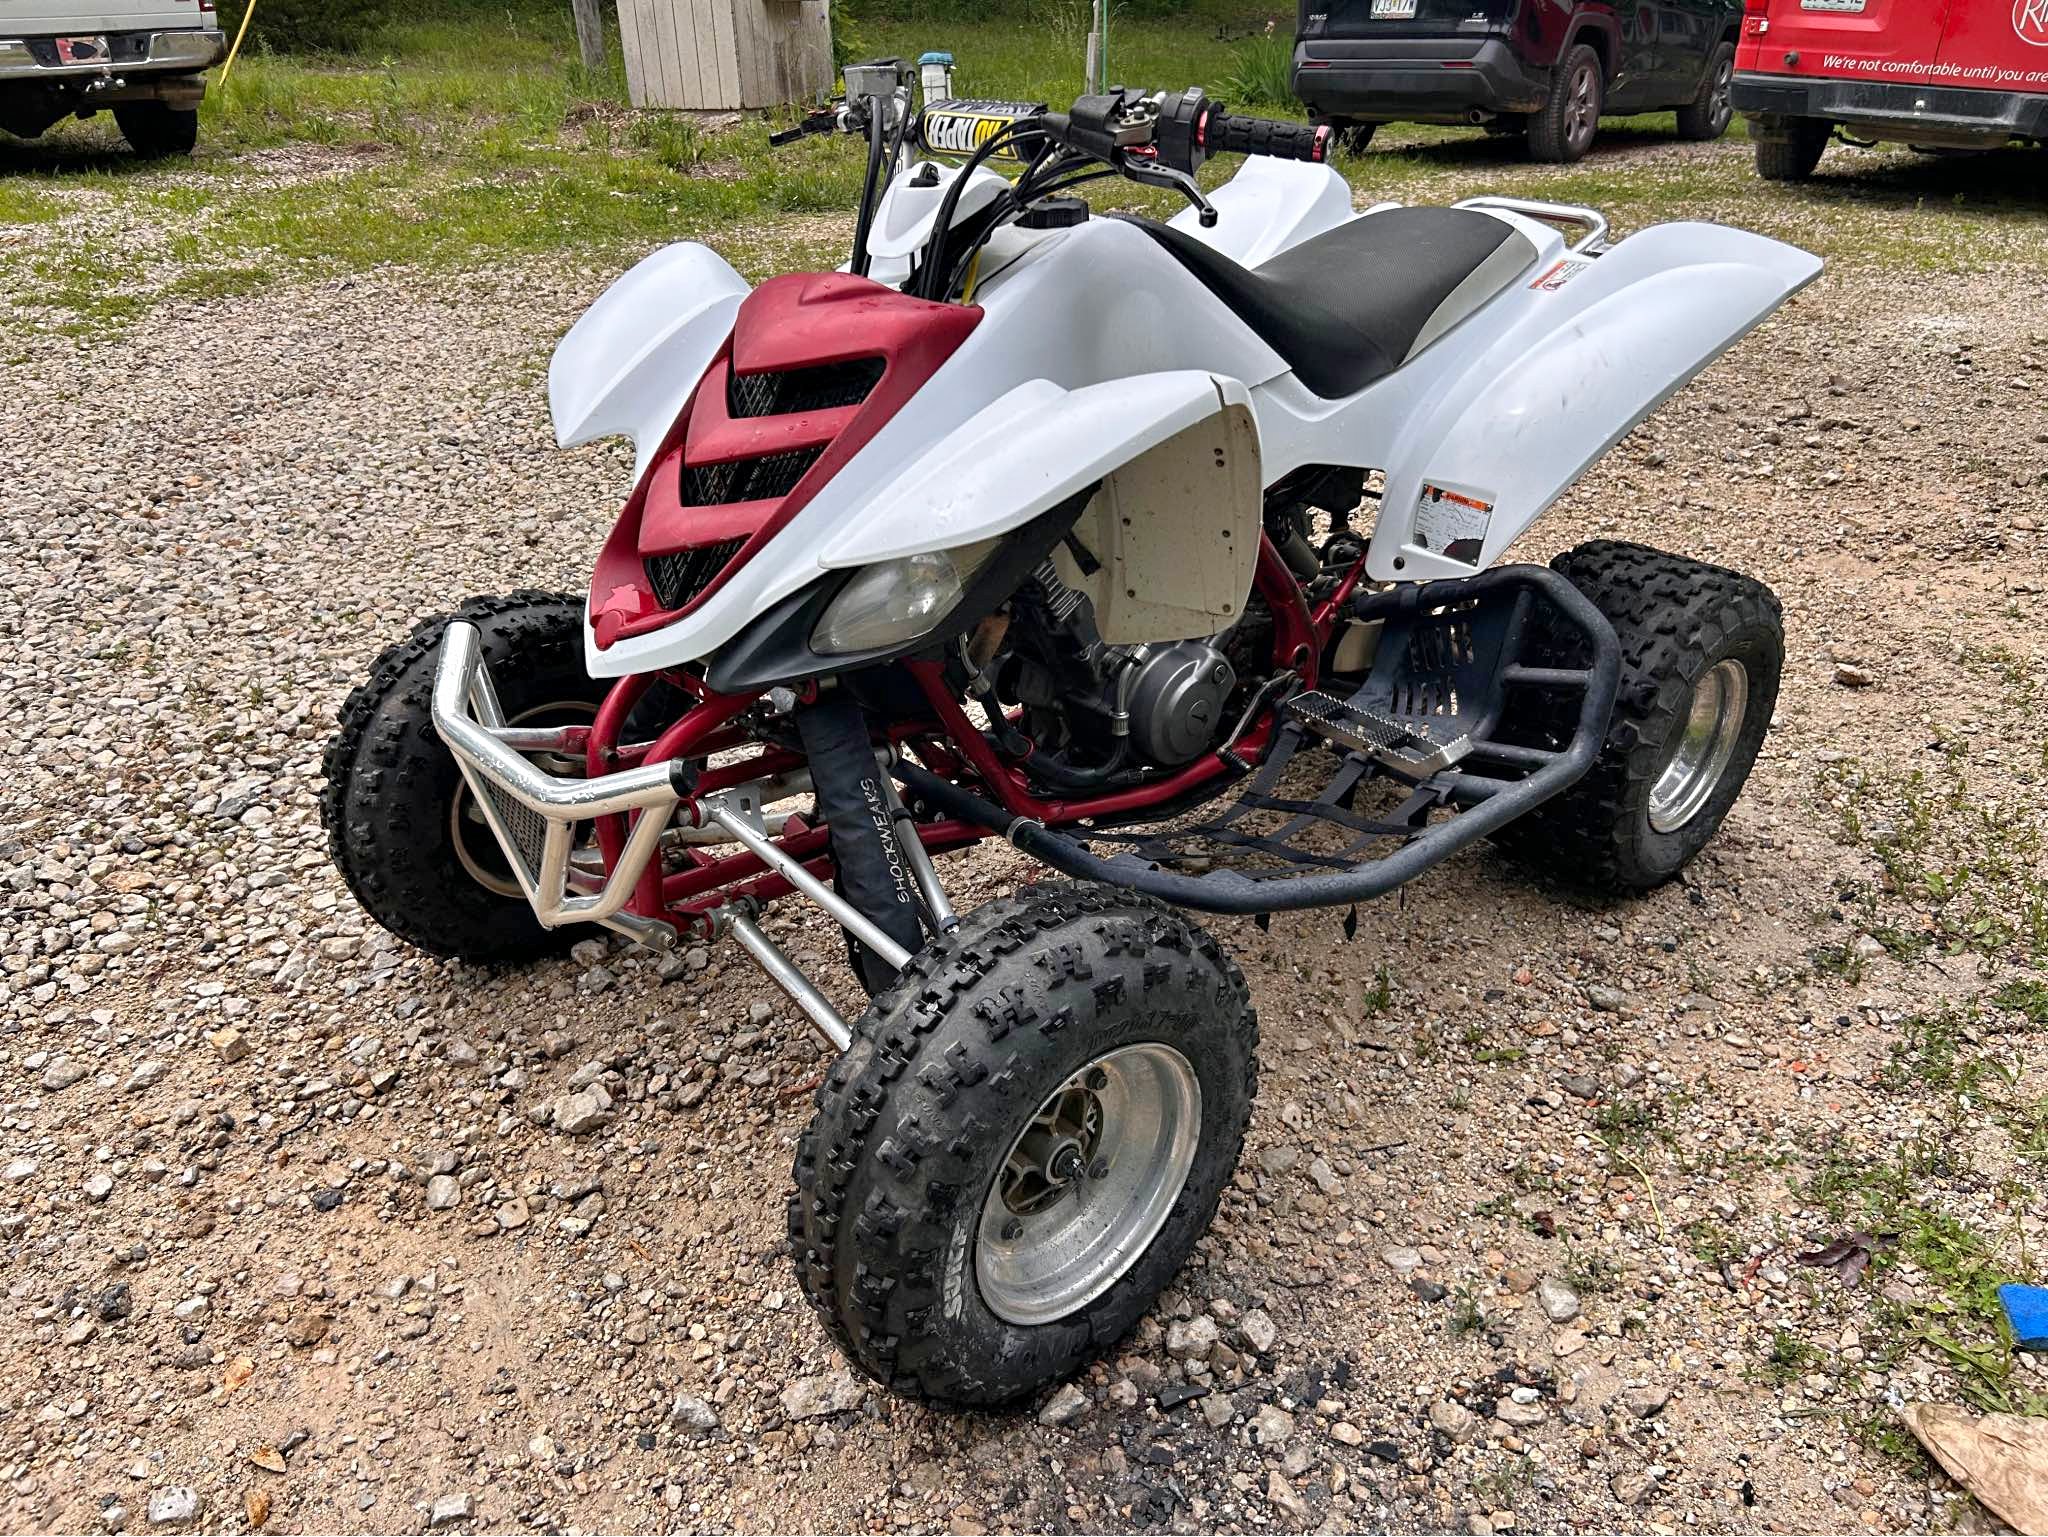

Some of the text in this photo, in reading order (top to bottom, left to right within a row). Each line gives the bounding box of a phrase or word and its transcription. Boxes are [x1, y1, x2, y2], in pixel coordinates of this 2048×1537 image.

[1823, 55, 2048, 83] We're not comfortable until you are
[861, 778, 909, 903] SHOCKWEARS
